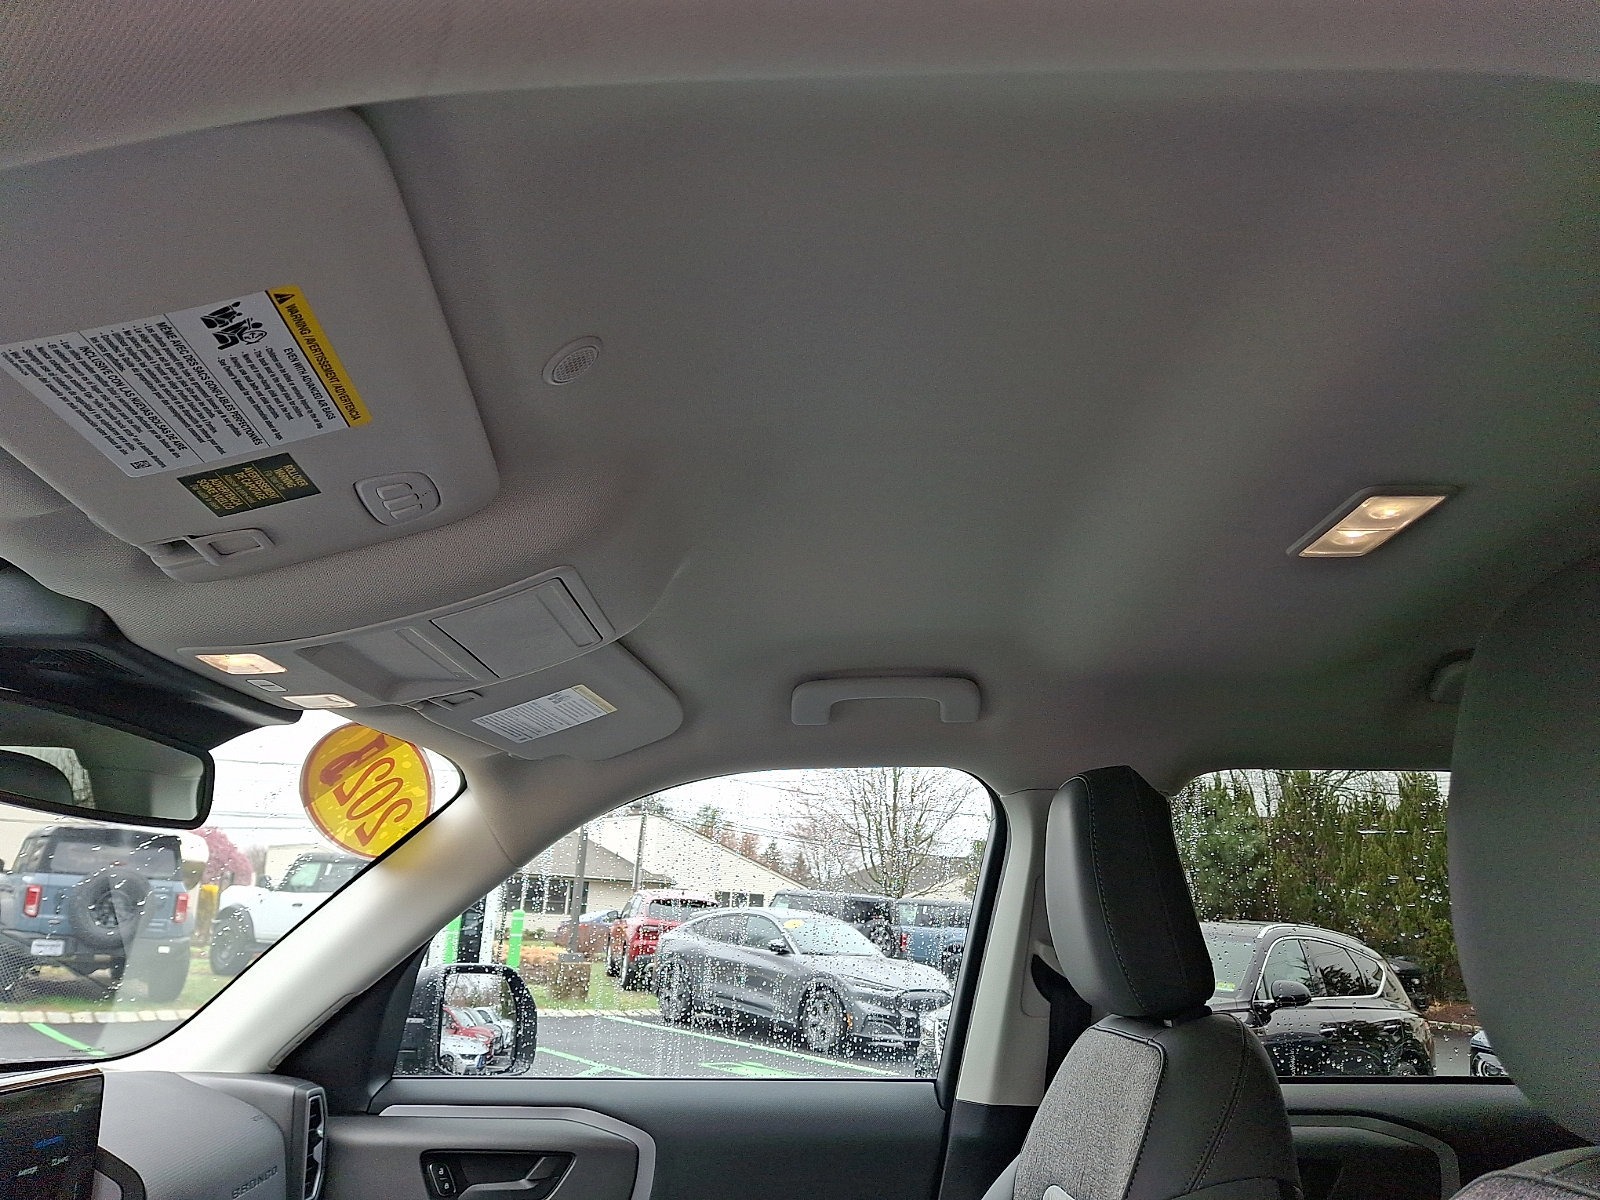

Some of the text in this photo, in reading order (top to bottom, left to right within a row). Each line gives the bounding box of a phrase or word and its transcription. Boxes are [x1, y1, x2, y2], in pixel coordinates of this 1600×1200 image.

[78, 345, 113, 375] INCLUSIVE
[107, 374, 125, 387] CON
[118, 386, 135, 397] LAS
[129, 396, 153, 416] NUEVAS
[147, 415, 170, 434] BOLSAS
[171, 440, 187, 450] AIRE
[156, 321, 177, 339] MÊME
[169, 339, 189, 354] AVEC
[182, 354, 198, 366] DES
[192, 365, 210, 380] SACS
[204, 380, 235, 411] GONFLABLES
[229, 410, 262, 445] PERFECTIONNÉS
[283, 347, 299, 362] EVEN
[292, 361, 307, 374] WITH
[321, 406, 335, 419] BAGS
[285, 303, 310, 334] WARNING
[304, 337, 339, 382] AVERTISSEMENT
[333, 385, 360, 420] ADVERTENCIA
[231, 1165, 279, 1200] BRONCO
